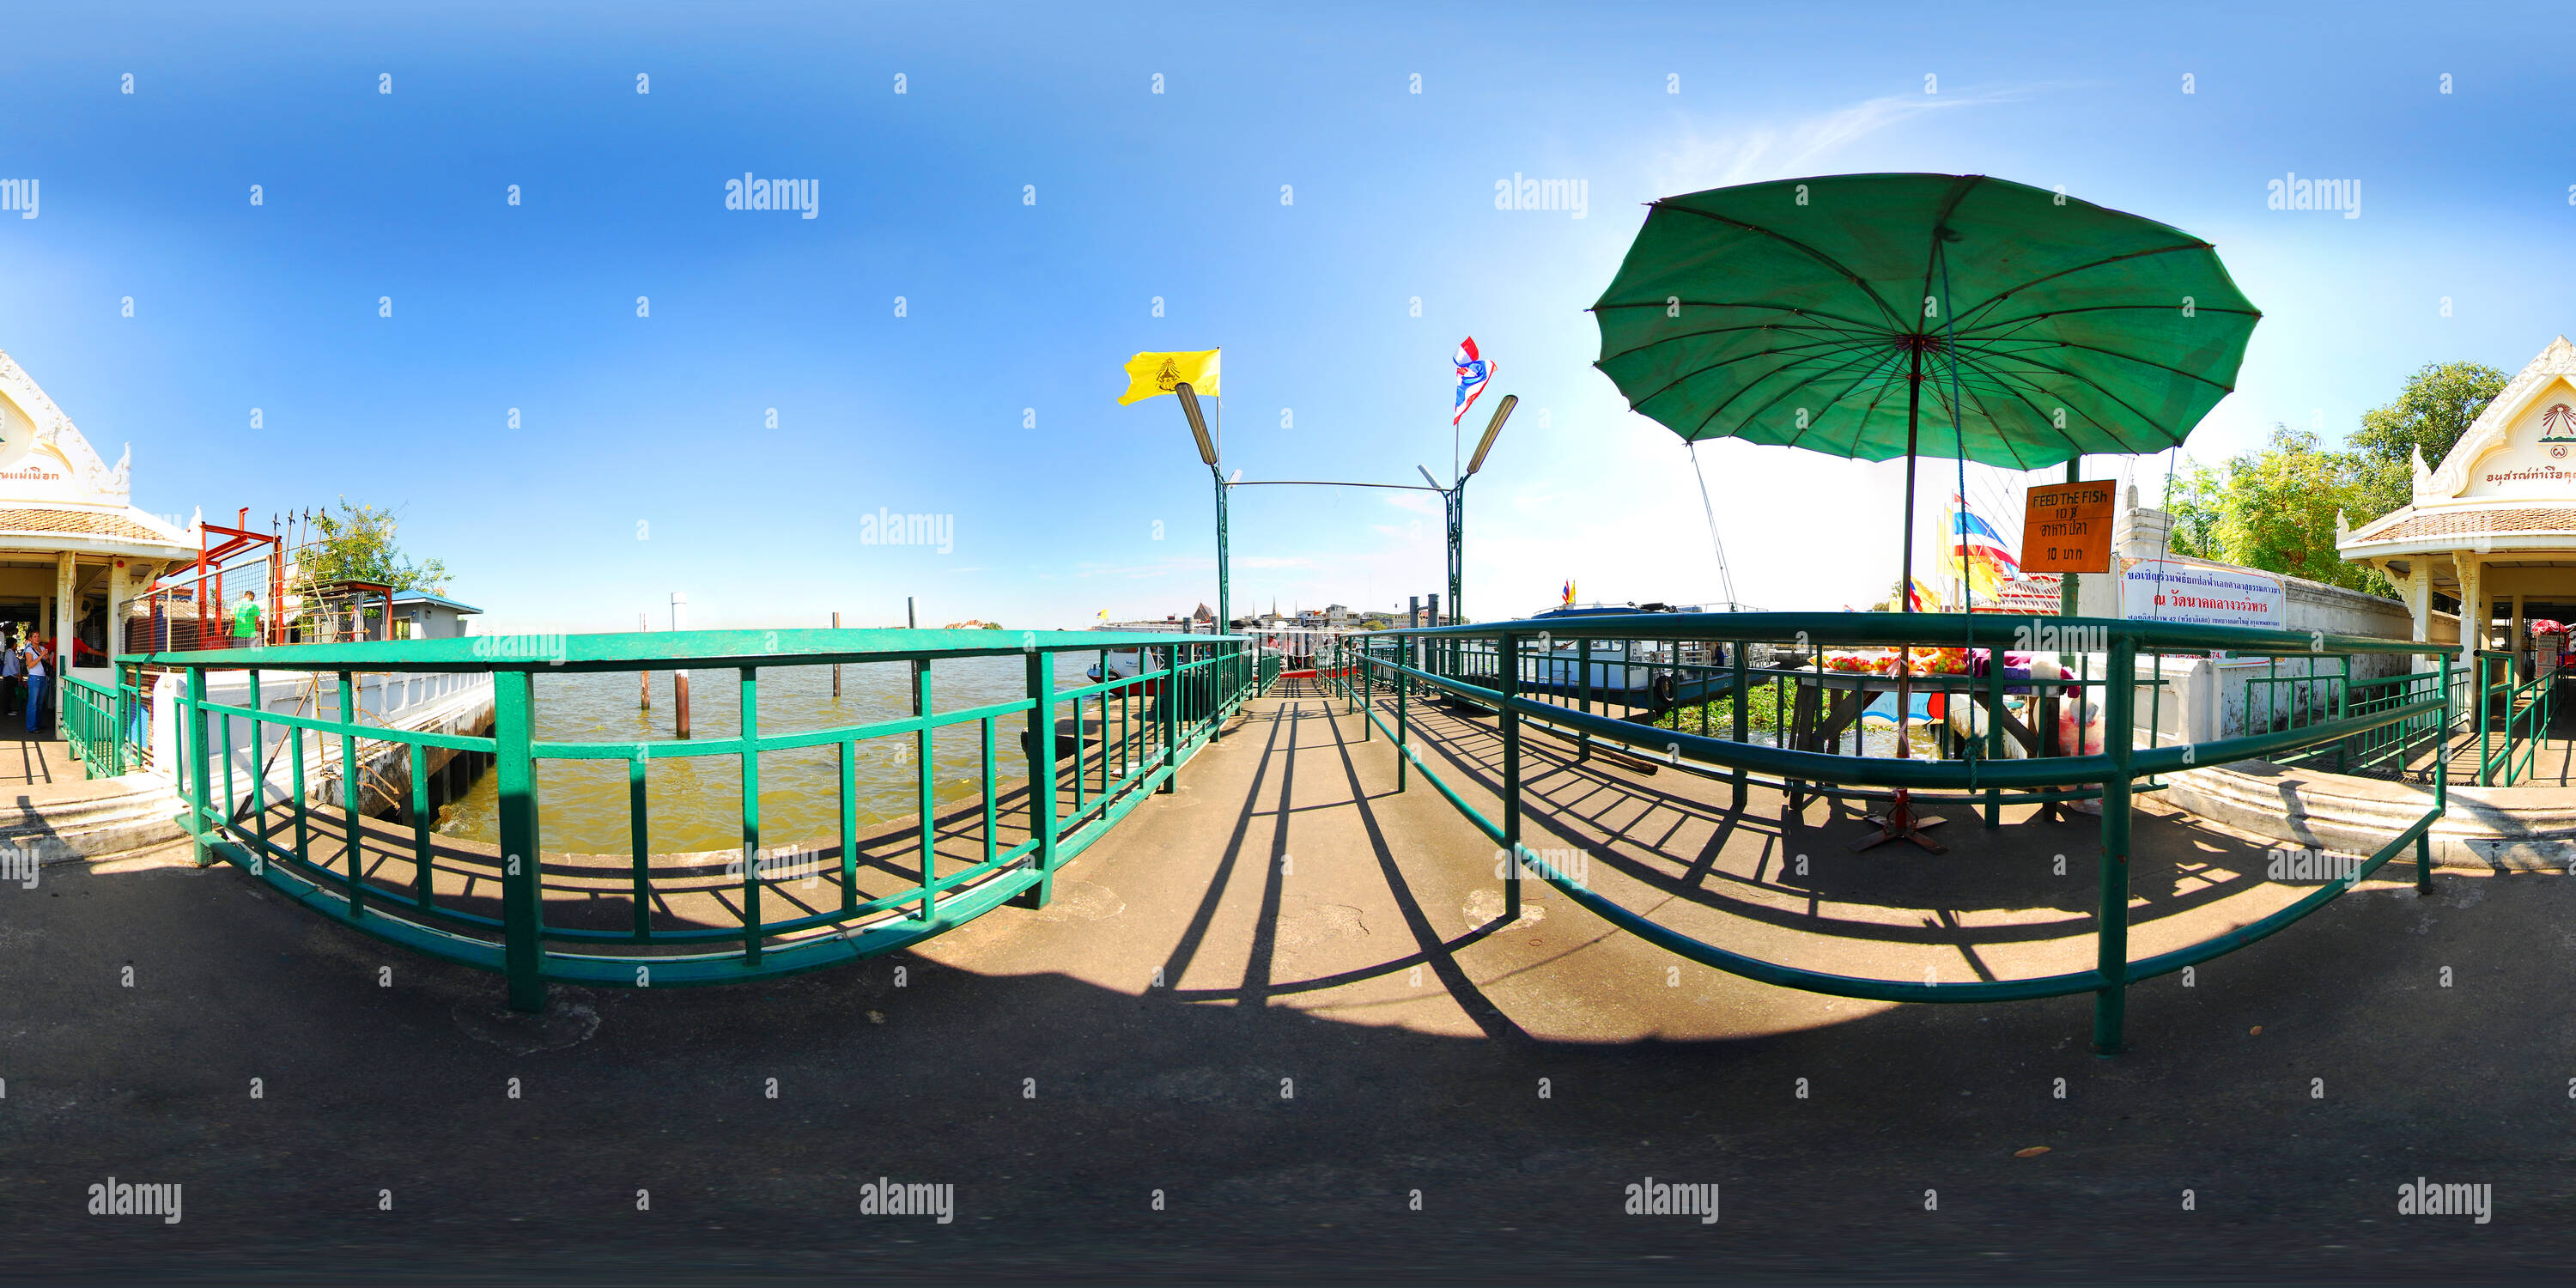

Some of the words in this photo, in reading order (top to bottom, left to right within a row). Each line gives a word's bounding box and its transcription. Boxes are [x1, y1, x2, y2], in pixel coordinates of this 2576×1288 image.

[2486, 465, 2576, 487] อนุสรณ์ท่าเรือคุ
[2032, 494, 2058, 507] FEED
[2056, 508, 2068, 519] 10
[2047, 547, 2057, 561] 10
[2063, 548, 2083, 561] บาท
[2154, 594, 2166, 606] ณ
[2171, 589, 2268, 612] วัดนาคกลางวรวิหาร
